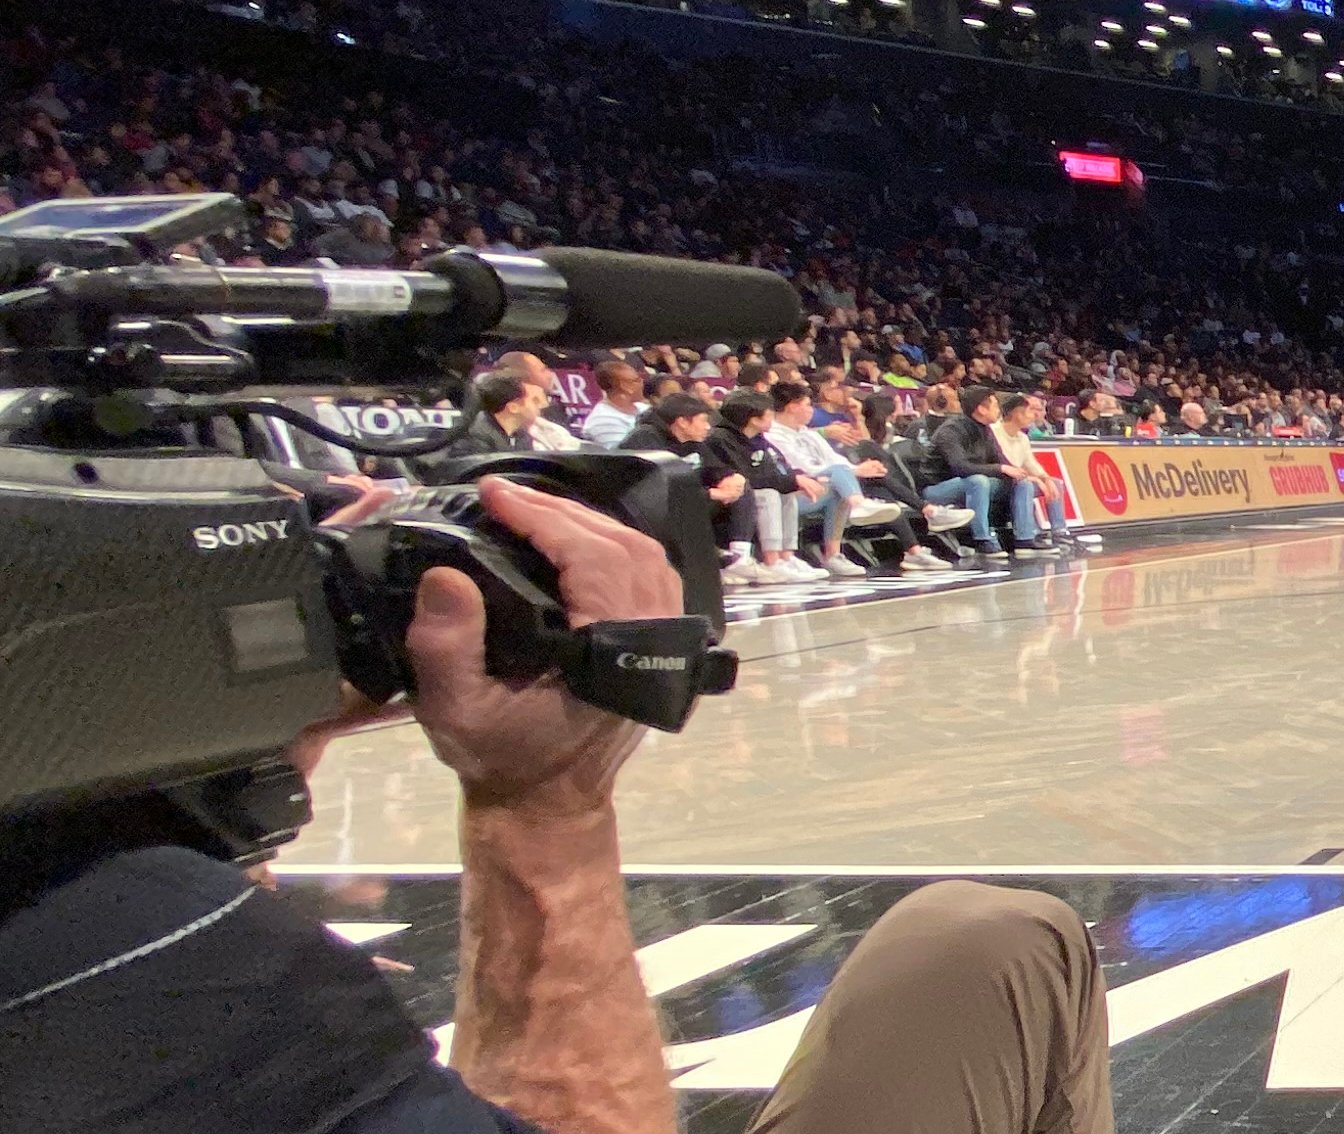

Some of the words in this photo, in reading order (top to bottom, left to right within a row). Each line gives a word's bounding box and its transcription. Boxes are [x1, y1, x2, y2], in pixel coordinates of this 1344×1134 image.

[1130, 459, 1250, 504] McDelivery
[192, 519, 289, 550] SONY
[616, 652, 686, 671] Canon
